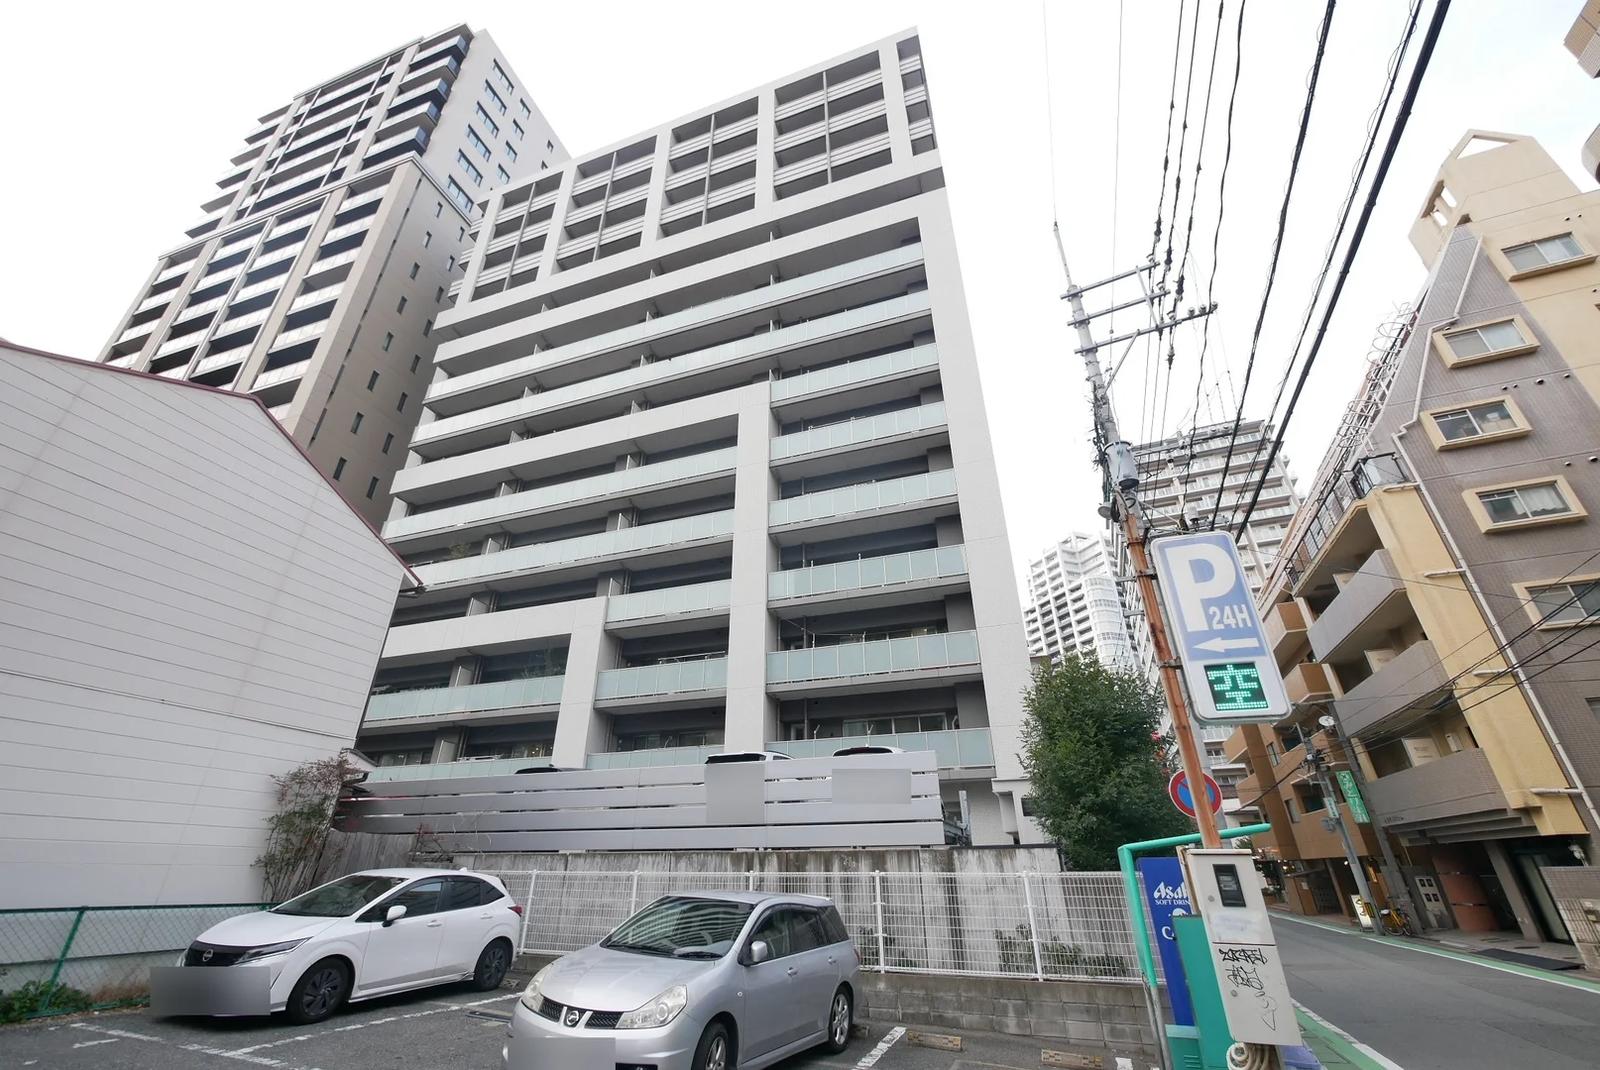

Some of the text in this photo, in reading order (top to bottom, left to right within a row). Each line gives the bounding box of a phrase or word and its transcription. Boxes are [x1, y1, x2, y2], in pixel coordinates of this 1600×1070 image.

[1164, 543, 1236, 633] P
[1208, 603, 1253, 630] 24H
[1207, 664, 1269, 710] 空
